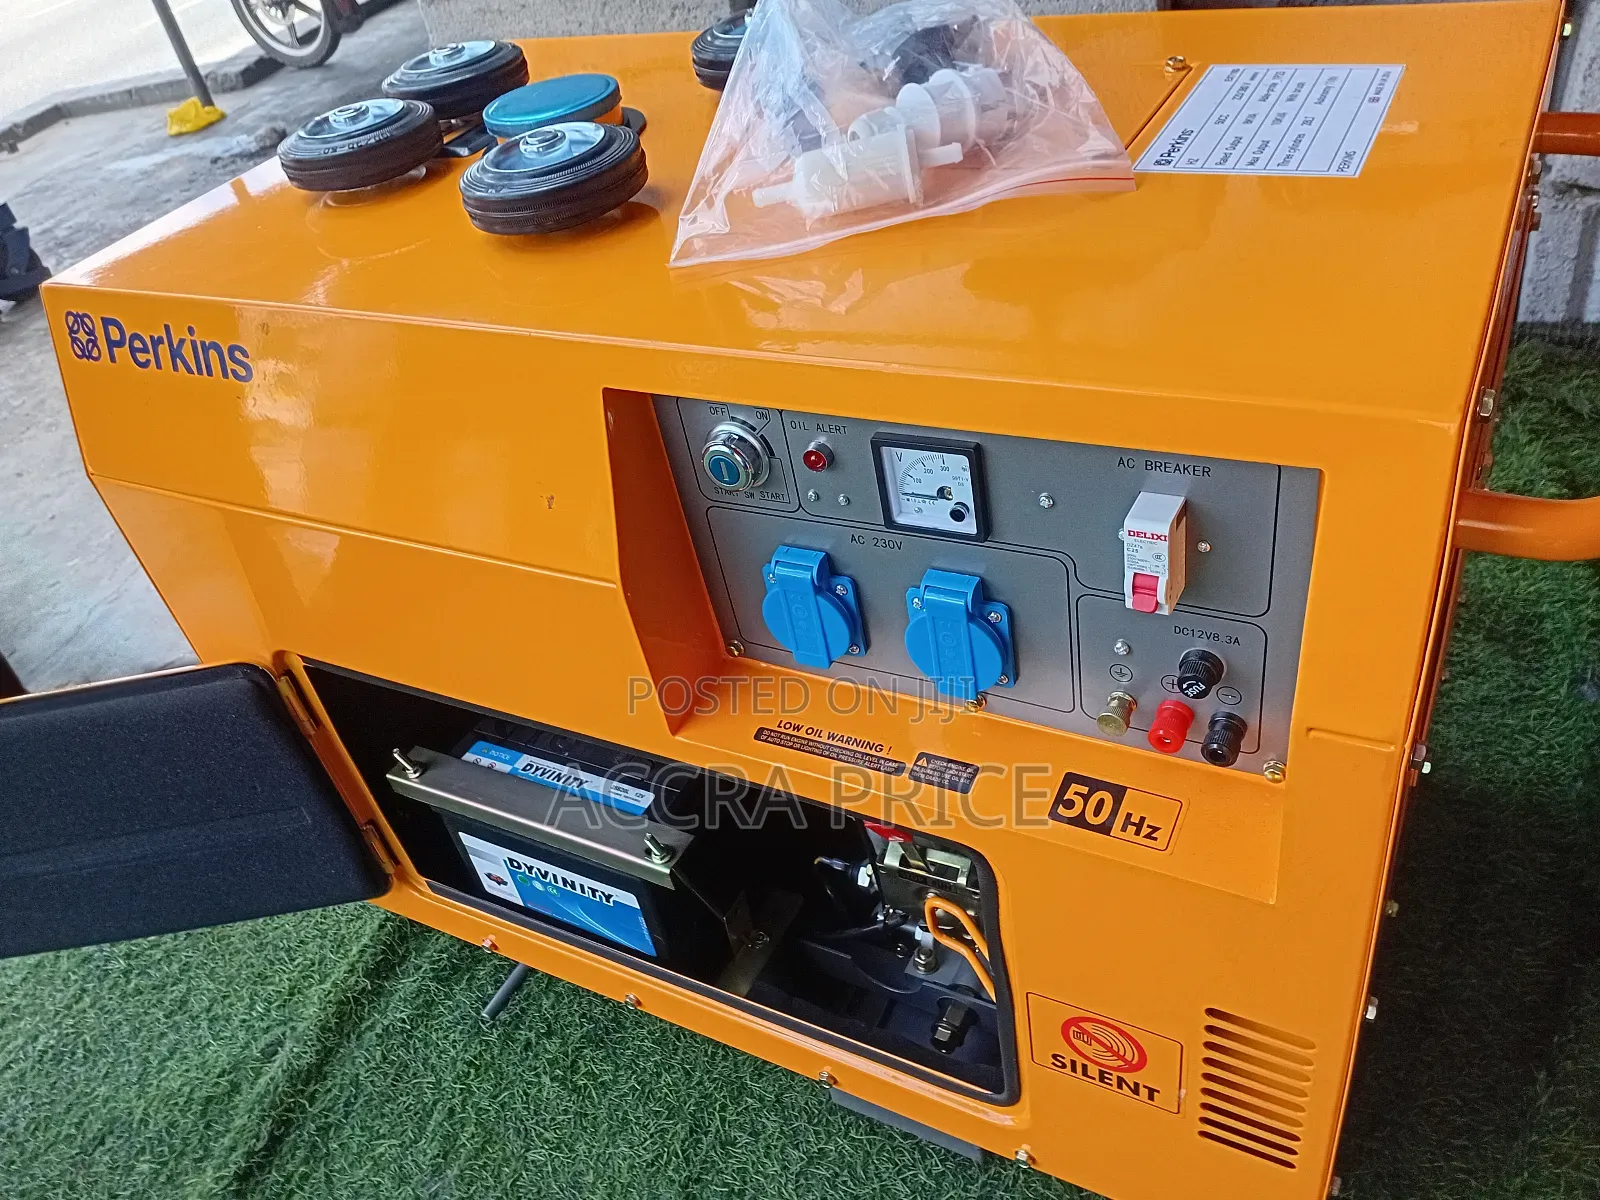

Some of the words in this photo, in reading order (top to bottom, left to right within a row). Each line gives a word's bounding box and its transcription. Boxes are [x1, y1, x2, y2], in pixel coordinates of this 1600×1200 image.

[1161, 129, 1195, 160] Perkins
[1215, 152, 1232, 166] Rated
[1225, 136, 1243, 150] Output
[1252, 140, 1271, 154] Output
[1245, 156, 1260, 166] Max
[1277, 153, 1294, 167] Three
[1336, 150, 1356, 172] PERKINS
[100, 316, 254, 383] Perkins
[709, 406, 726, 416] OFF
[755, 410, 768, 420] ON
[790, 421, 809, 430] OIL
[816, 423, 848, 435] ALERT
[895, 452, 903, 462] V
[1117, 456, 1136, 470] AC
[1144, 460, 1212, 478] BREAKER
[760, 490, 786, 500] START
[850, 534, 866, 545] AC
[873, 536, 904, 551] 230V
[1127, 529, 1168, 543] DELIXI
[1174, 625, 1240, 646] DC12V8.3A
[1184, 682, 1206, 698] FUSE
[776, 720, 804, 734] LOW
[805, 726, 824, 739] OIL
[826, 732, 885, 754] WARNING
[801, 745, 822, 754] LIGHTING
[838, 755, 864, 765] PRESSURE
[808, 741, 829, 750] WITHOUT
[830, 747, 854, 756] CHECKING
[863, 755, 878, 763] LEVEL
[520, 762, 590, 789] DYVINITY
[1056, 783, 1114, 826] 50
[1120, 812, 1162, 842] Hz
[506, 856, 616, 904] DYVINITY
[1051, 1053, 1160, 1102] SILENT
